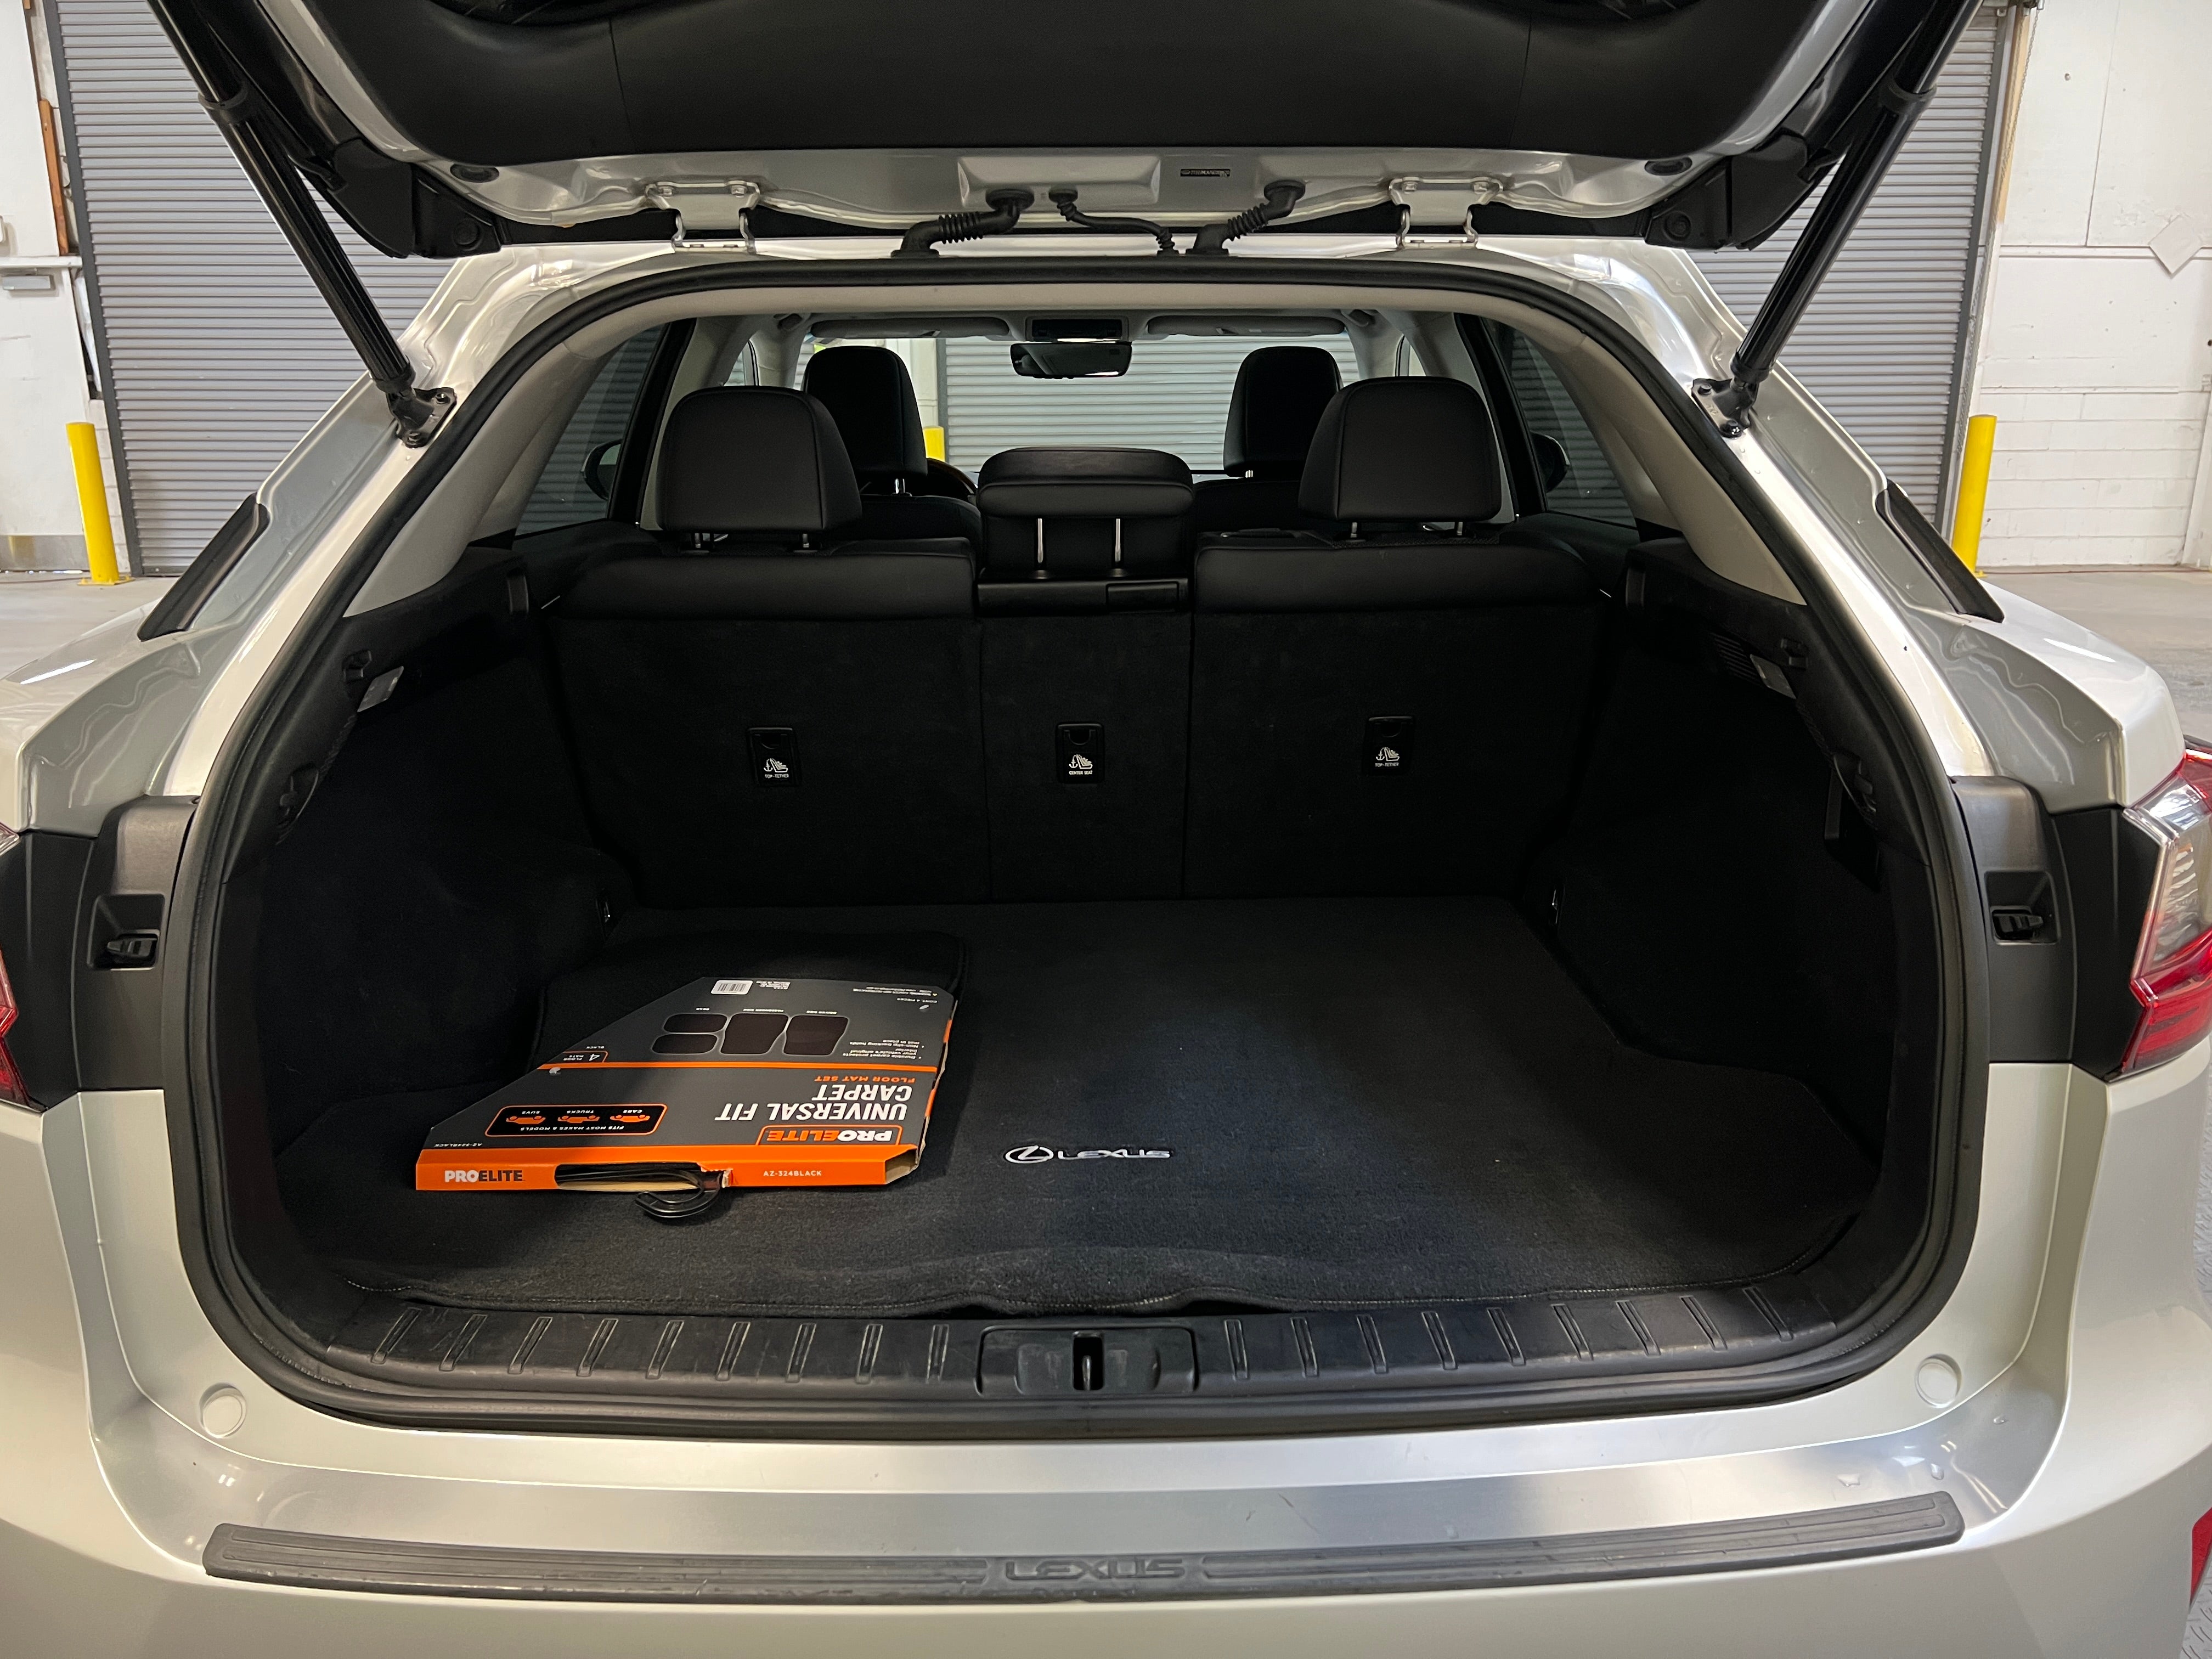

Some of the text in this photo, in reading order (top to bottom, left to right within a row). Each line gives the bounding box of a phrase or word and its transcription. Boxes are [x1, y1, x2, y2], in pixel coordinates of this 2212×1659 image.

[811, 1084, 913, 1102] CARPET
[714, 1103, 907, 1121] UNIVERSAL FIT
[766, 1130, 893, 1142] PROELITE
[1058, 1149, 1171, 1160] LEXUS
[444, 1170, 523, 1182] PROELITE
[1005, 1558, 1186, 1581] LEXUS
